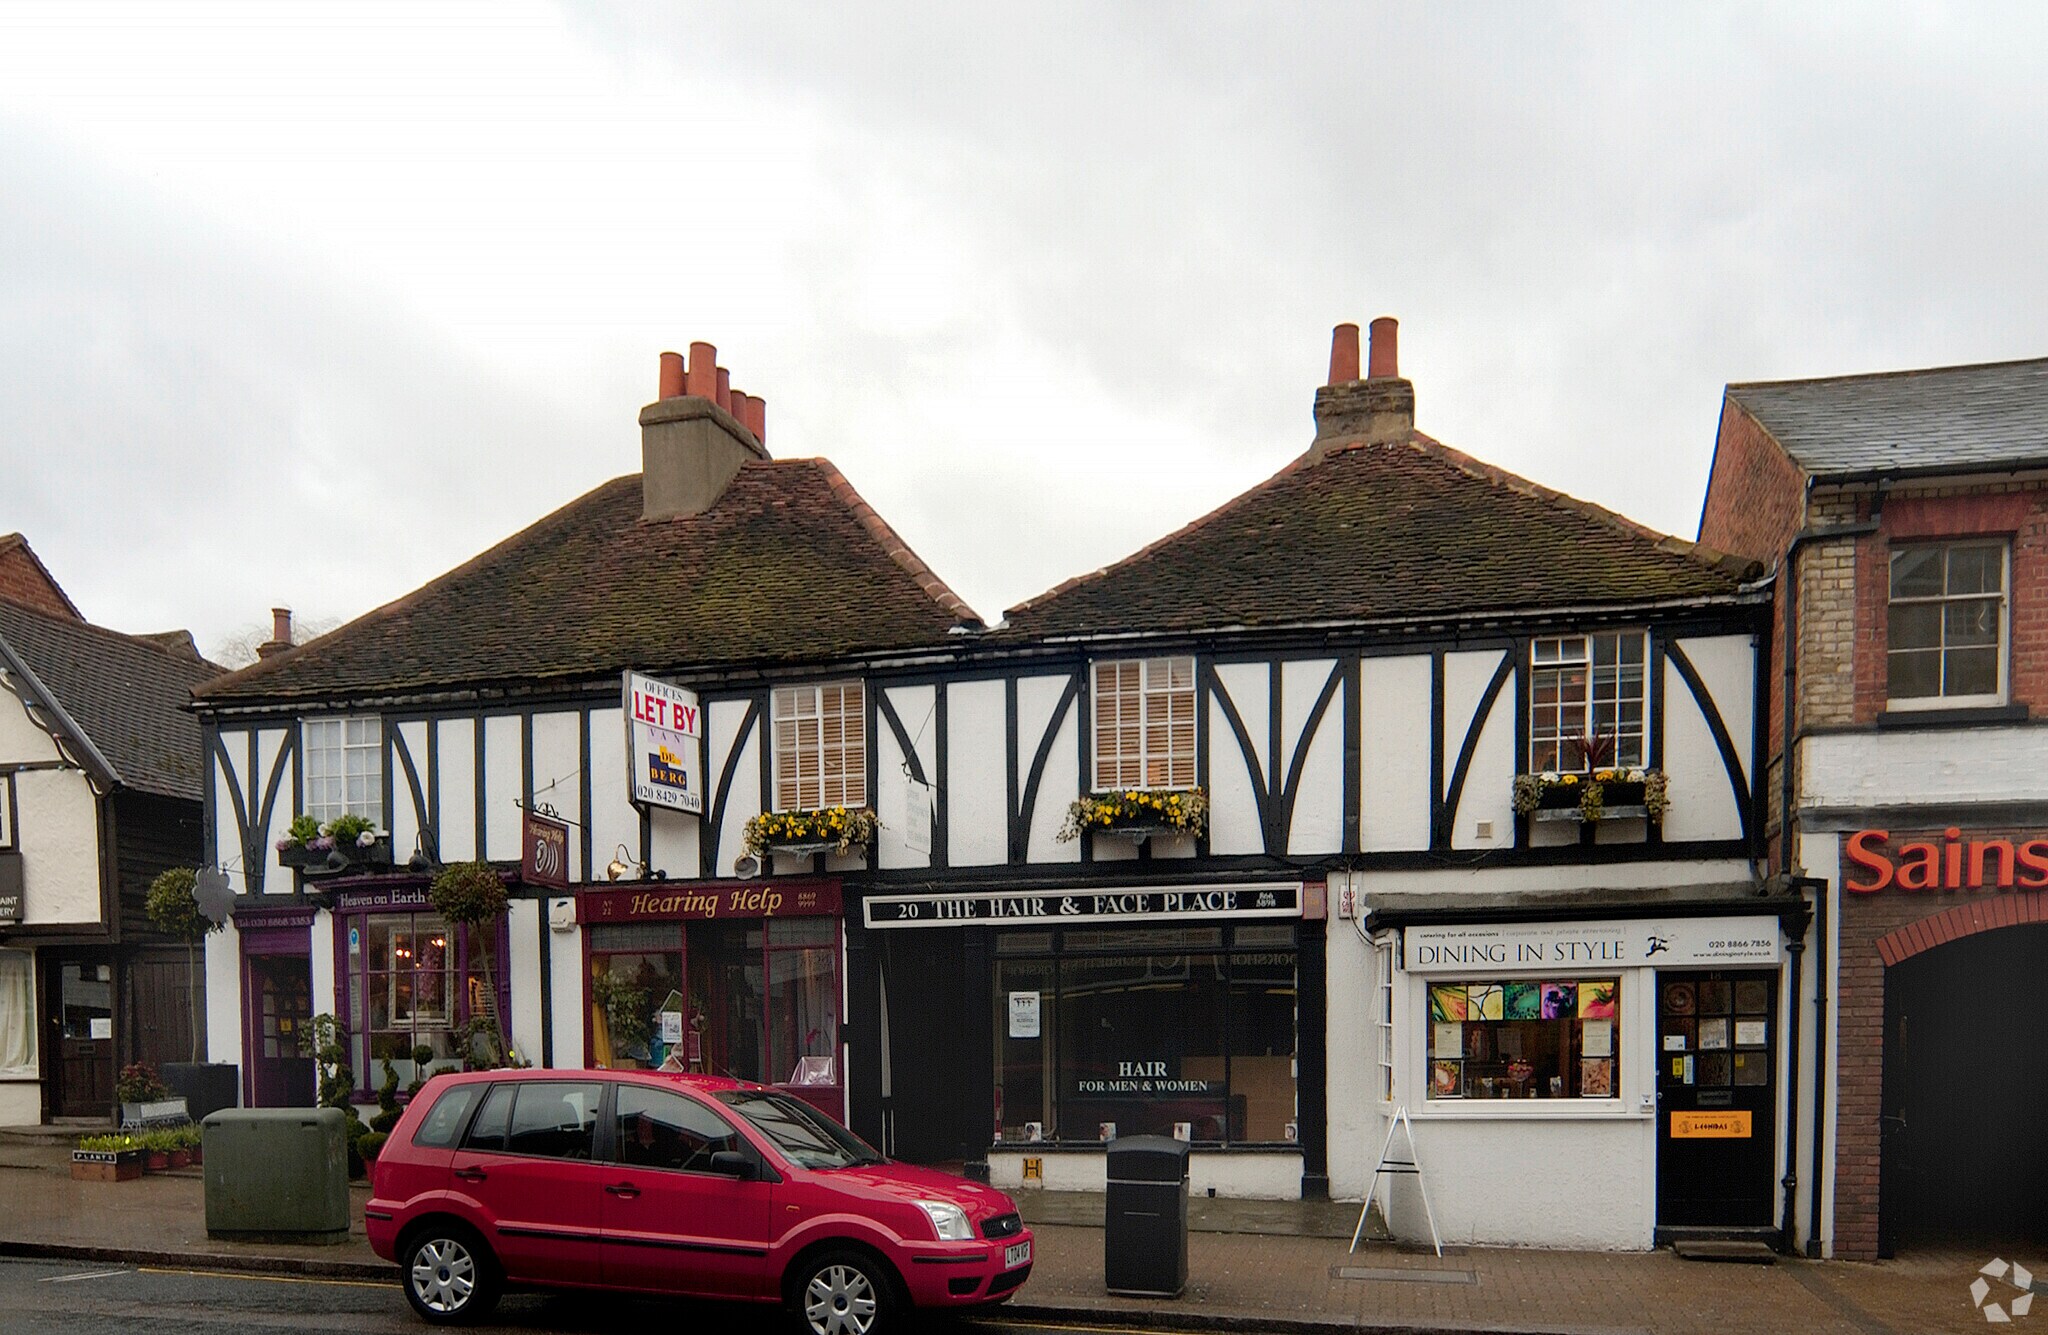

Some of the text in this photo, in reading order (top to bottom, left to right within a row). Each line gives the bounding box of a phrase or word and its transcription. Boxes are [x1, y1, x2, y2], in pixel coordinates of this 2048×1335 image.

[644, 680, 683, 702] OFFICES
[634, 690, 697, 734] LET BY
[650, 728, 681, 743] VAN
[661, 751, 677, 764] DE
[651, 767, 687, 786] BERG
[637, 783, 701, 810] 020 8429 7040
[340, 887, 425, 907] Heaven on Earth
[630, 887, 783, 918] Hearing Help
[898, 891, 1238, 919] 20 THE HAIR & FACE PLACE
[1419, 940, 1625, 965] DINING IN STYLE
[1727, 940, 1749, 948] 8866
[1118, 1061, 1168, 1077] HAIR
[1078, 1081, 1208, 1092] FOR MEN & WOMEN
